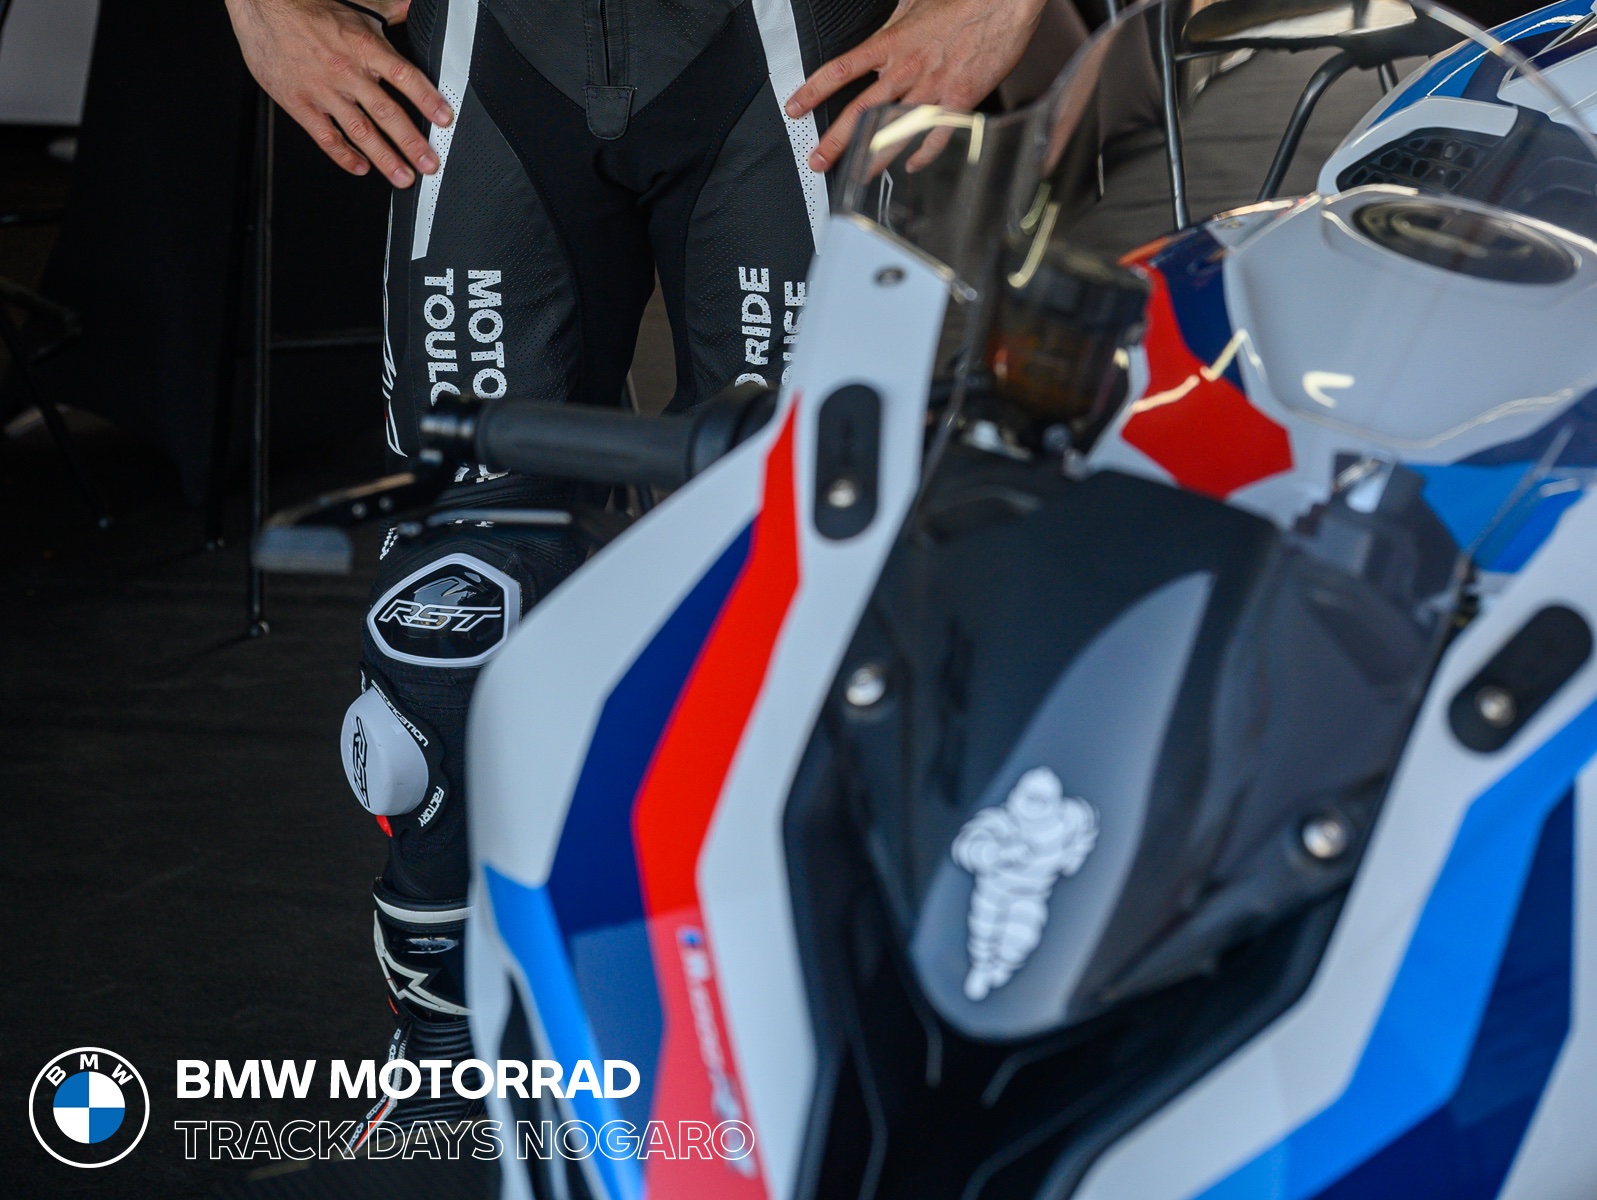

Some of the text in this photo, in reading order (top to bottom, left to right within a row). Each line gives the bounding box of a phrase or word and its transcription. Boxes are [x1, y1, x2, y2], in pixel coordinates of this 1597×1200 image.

[424, 268, 461, 406] TOUL
[467, 269, 508, 399] MOTO
[738, 266, 772, 366] RIDE
[379, 599, 502, 632] RST
